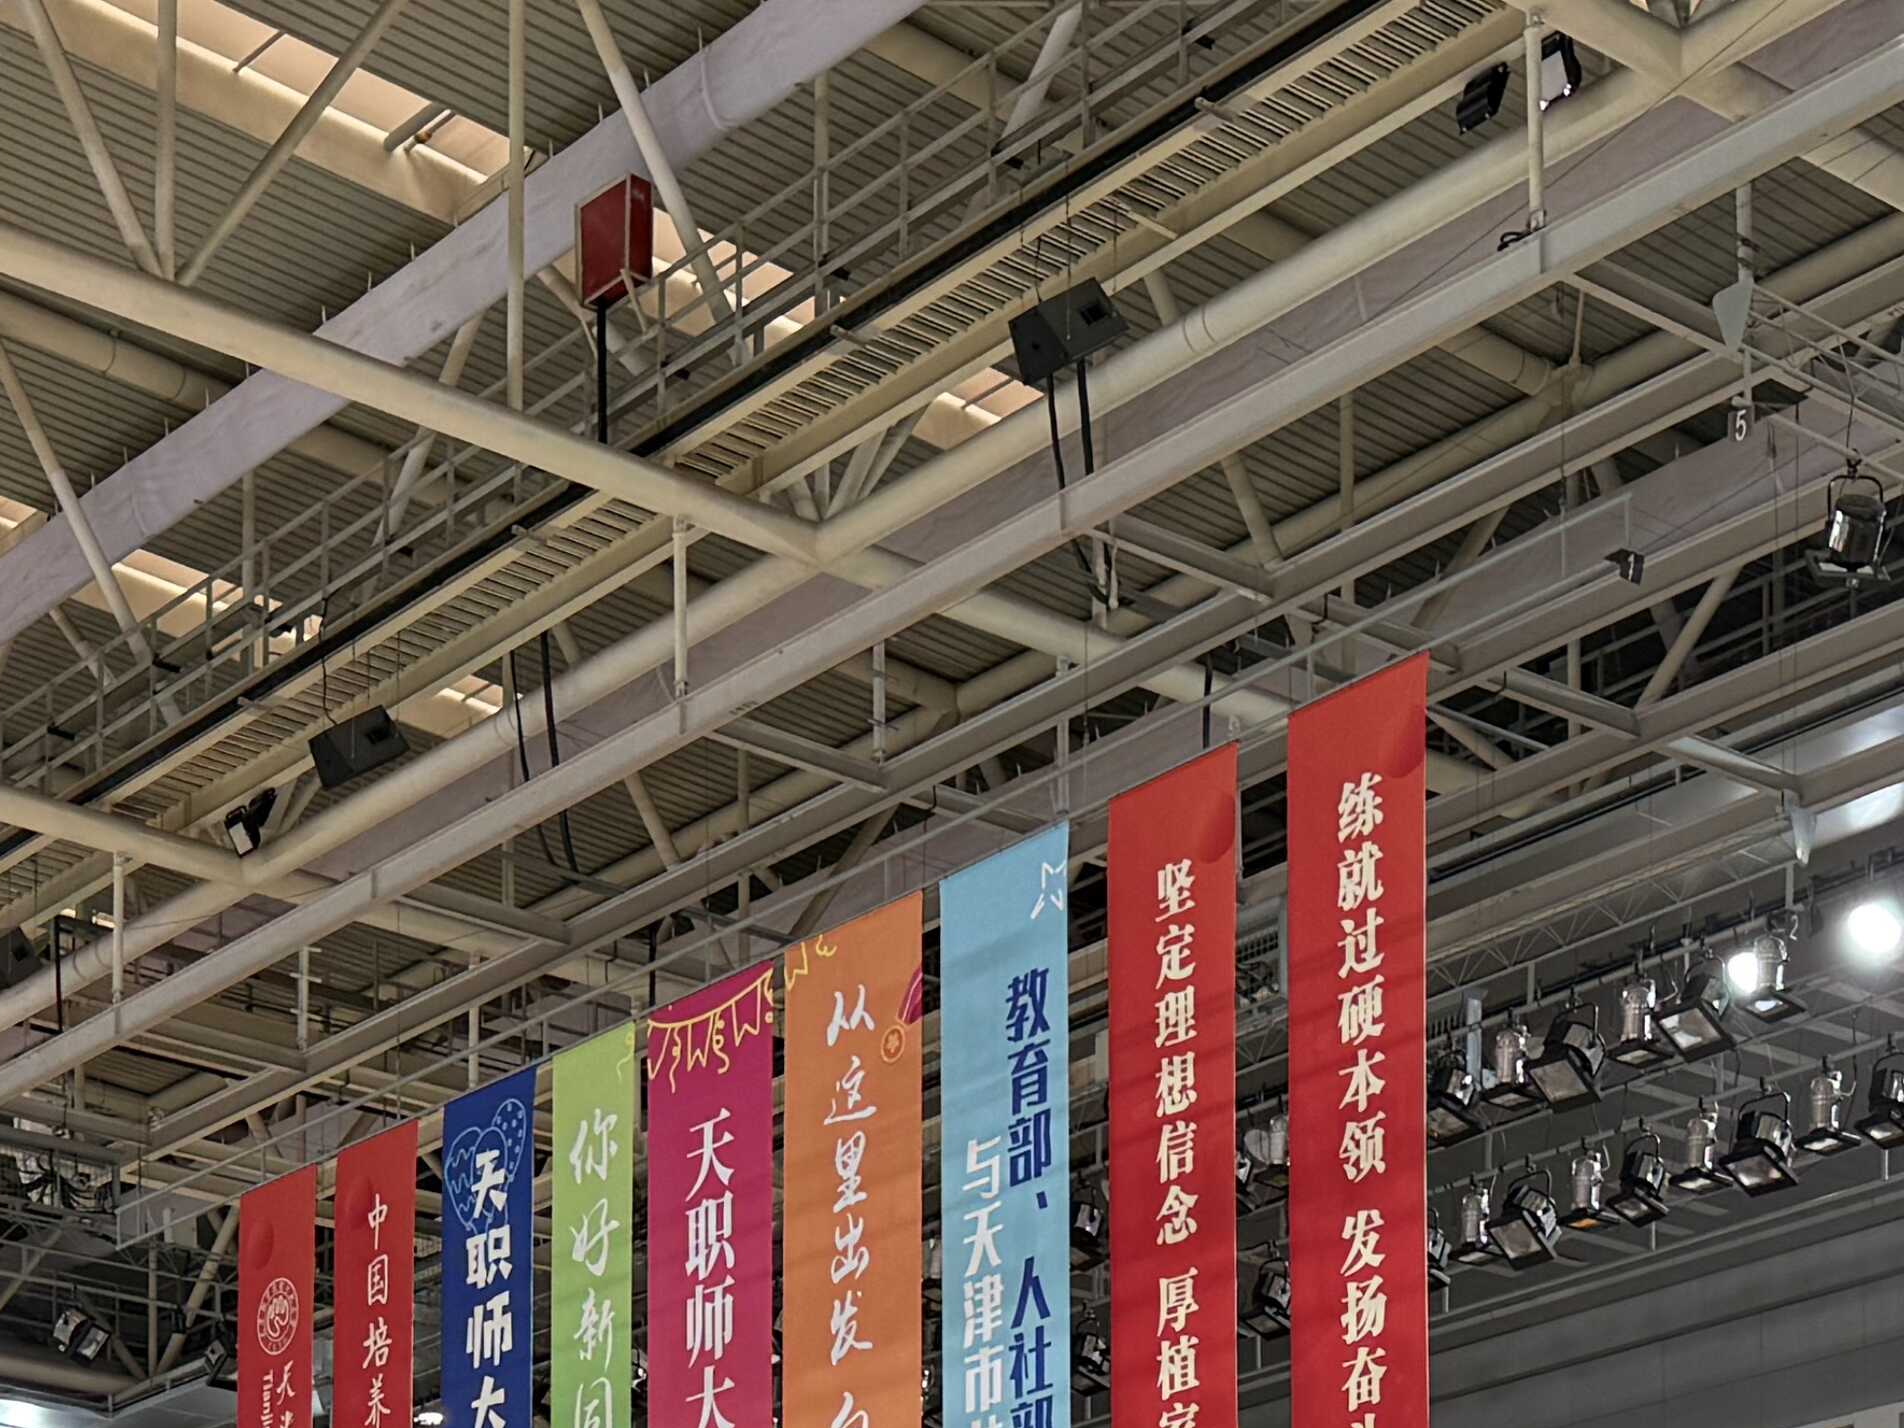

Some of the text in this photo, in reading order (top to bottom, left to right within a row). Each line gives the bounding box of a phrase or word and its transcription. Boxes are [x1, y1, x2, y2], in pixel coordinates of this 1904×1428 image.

[1153, 858, 1199, 1247] 坚定理想信念
[1337, 771, 1388, 1184] 练就过硬本领
[823, 983, 878, 1367] 从这里出发
